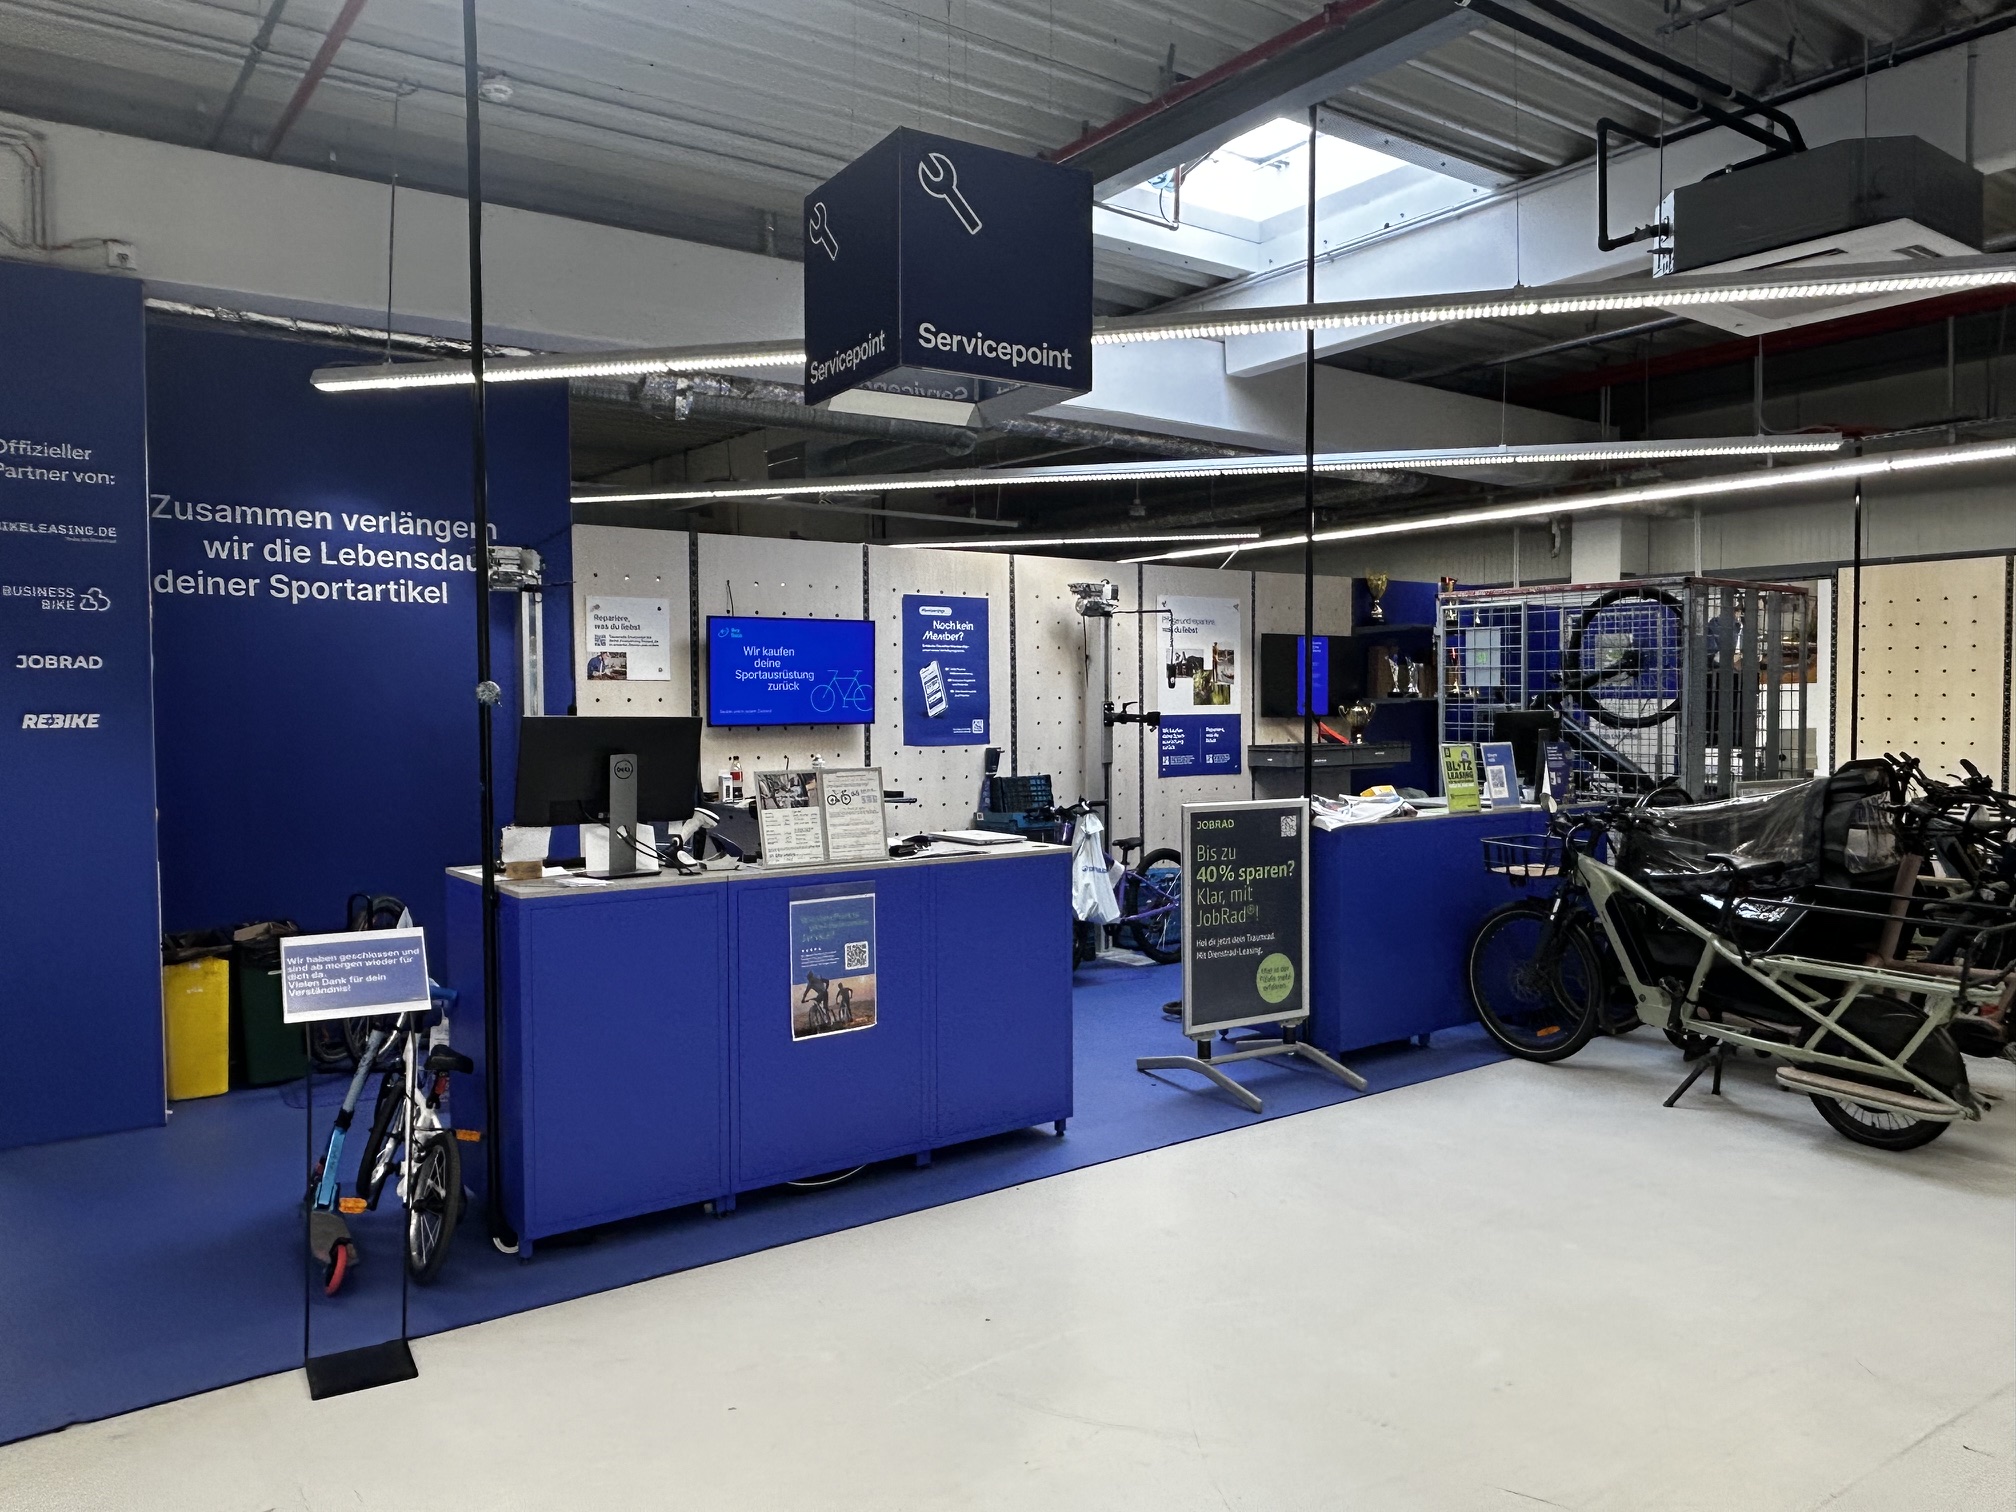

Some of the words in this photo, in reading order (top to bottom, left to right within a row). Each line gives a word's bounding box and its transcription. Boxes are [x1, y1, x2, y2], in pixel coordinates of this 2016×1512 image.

[918, 322, 1072, 370] Servicepoint
[810, 330, 886, 384] Servicepoint
[73, 471, 116, 485] von:
[150, 494, 332, 530] Zusammen
[0, 521, 117, 537] IKELEASING.DE
[203, 535, 254, 561] wir
[263, 538, 311, 563] die
[320, 541, 479, 572] Lebensdau
[2, 585, 75, 598] BUSINESS
[153, 570, 260, 597] deiner
[269, 574, 449, 604] Sportartikel
[41, 599, 75, 610] BIKE
[933, 620, 956, 630] Noch
[956, 621, 974, 630] kein
[922, 630, 964, 641] Member?
[743, 646, 760, 656] Wir
[762, 646, 795, 656] kaufen
[16, 654, 103, 669] JOBRAD
[754, 658, 781, 668] deine
[735, 669, 815, 681] Sportausrüstung
[767, 681, 800, 691] zurück
[1196, 819, 1235, 830] JOBRAD
[1197, 845, 1217, 862] Bis
[1221, 847, 1236, 860] zu
[1196, 865, 1217, 883] 40
[1219, 864, 1235, 882] %
[1238, 860, 1295, 885] sparen?
[1197, 887, 1226, 905] Klar,
[1230, 885, 1253, 903] mit
[287, 957, 303, 965] Wir
[306, 954, 337, 964] haben
[339, 950, 400, 962] geschlossen
[401, 948, 420, 956] und
[287, 964, 308, 973] sind
[310, 963, 323, 971] ab
[325, 961, 363, 970] morgen
[364, 958, 397, 967] wieder
[399, 955, 414, 964] für
[287, 972, 309, 981] dich
[311, 971, 327, 979] da.
[288, 980, 320, 989] Vielen
[322, 977, 347, 986] Dank
[349, 975, 364, 984] für
[365, 973, 387, 982] dein
[288, 984, 351, 997] Verständnis!
